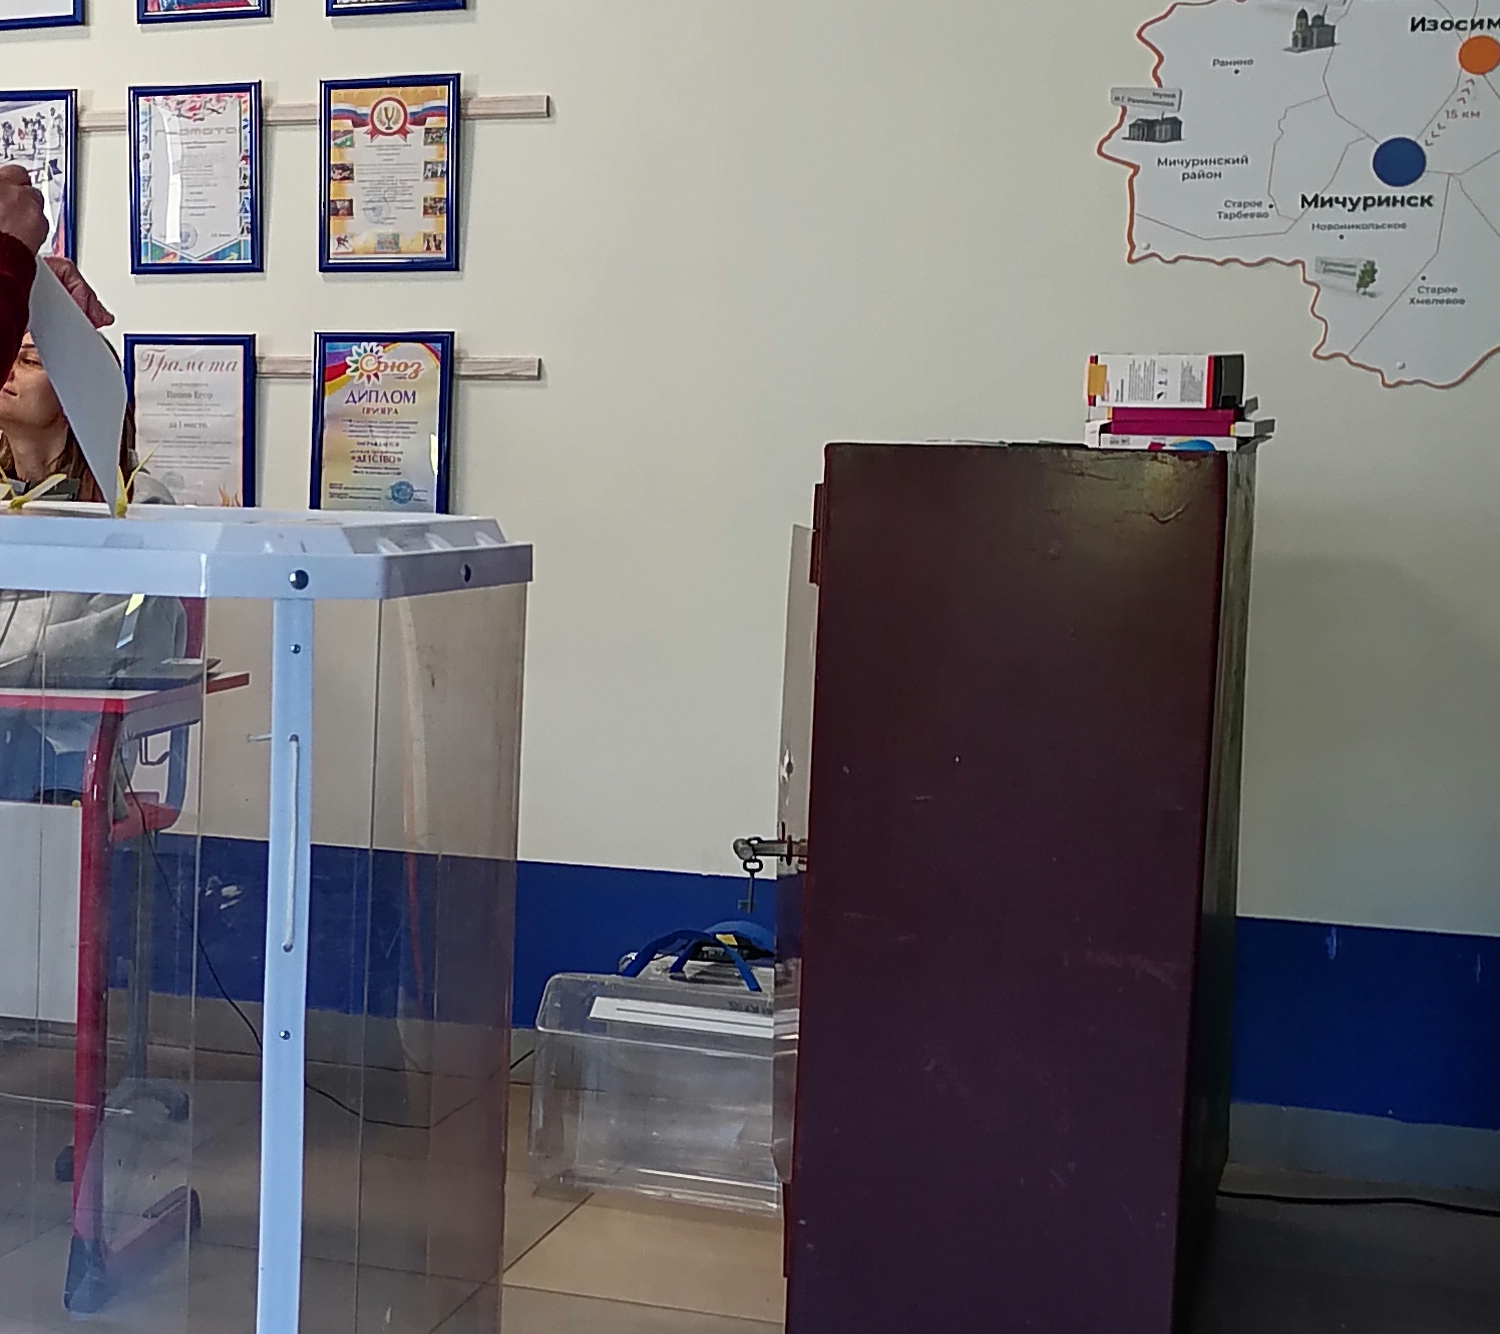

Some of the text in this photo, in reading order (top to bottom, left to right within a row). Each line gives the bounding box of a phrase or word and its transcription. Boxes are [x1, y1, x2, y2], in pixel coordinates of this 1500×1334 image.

[1410, 16, 1500, 33] Изосим
[1212, 58, 1254, 67] Ранино
[1445, 110, 1480, 119] 15 км
[1157, 155, 1249, 168] Мичуринский
[1181, 170, 1222, 182] район
[1224, 199, 1263, 209] Старое
[1300, 193, 1434, 212] Мичуринск
[1217, 210, 1269, 220] Тарбеево
[1417, 285, 1458, 294] Старое
[141, 348, 238, 382] Грамота
[359, 353, 424, 379] Союз
[345, 389, 416, 405] ДИПЛОМ
